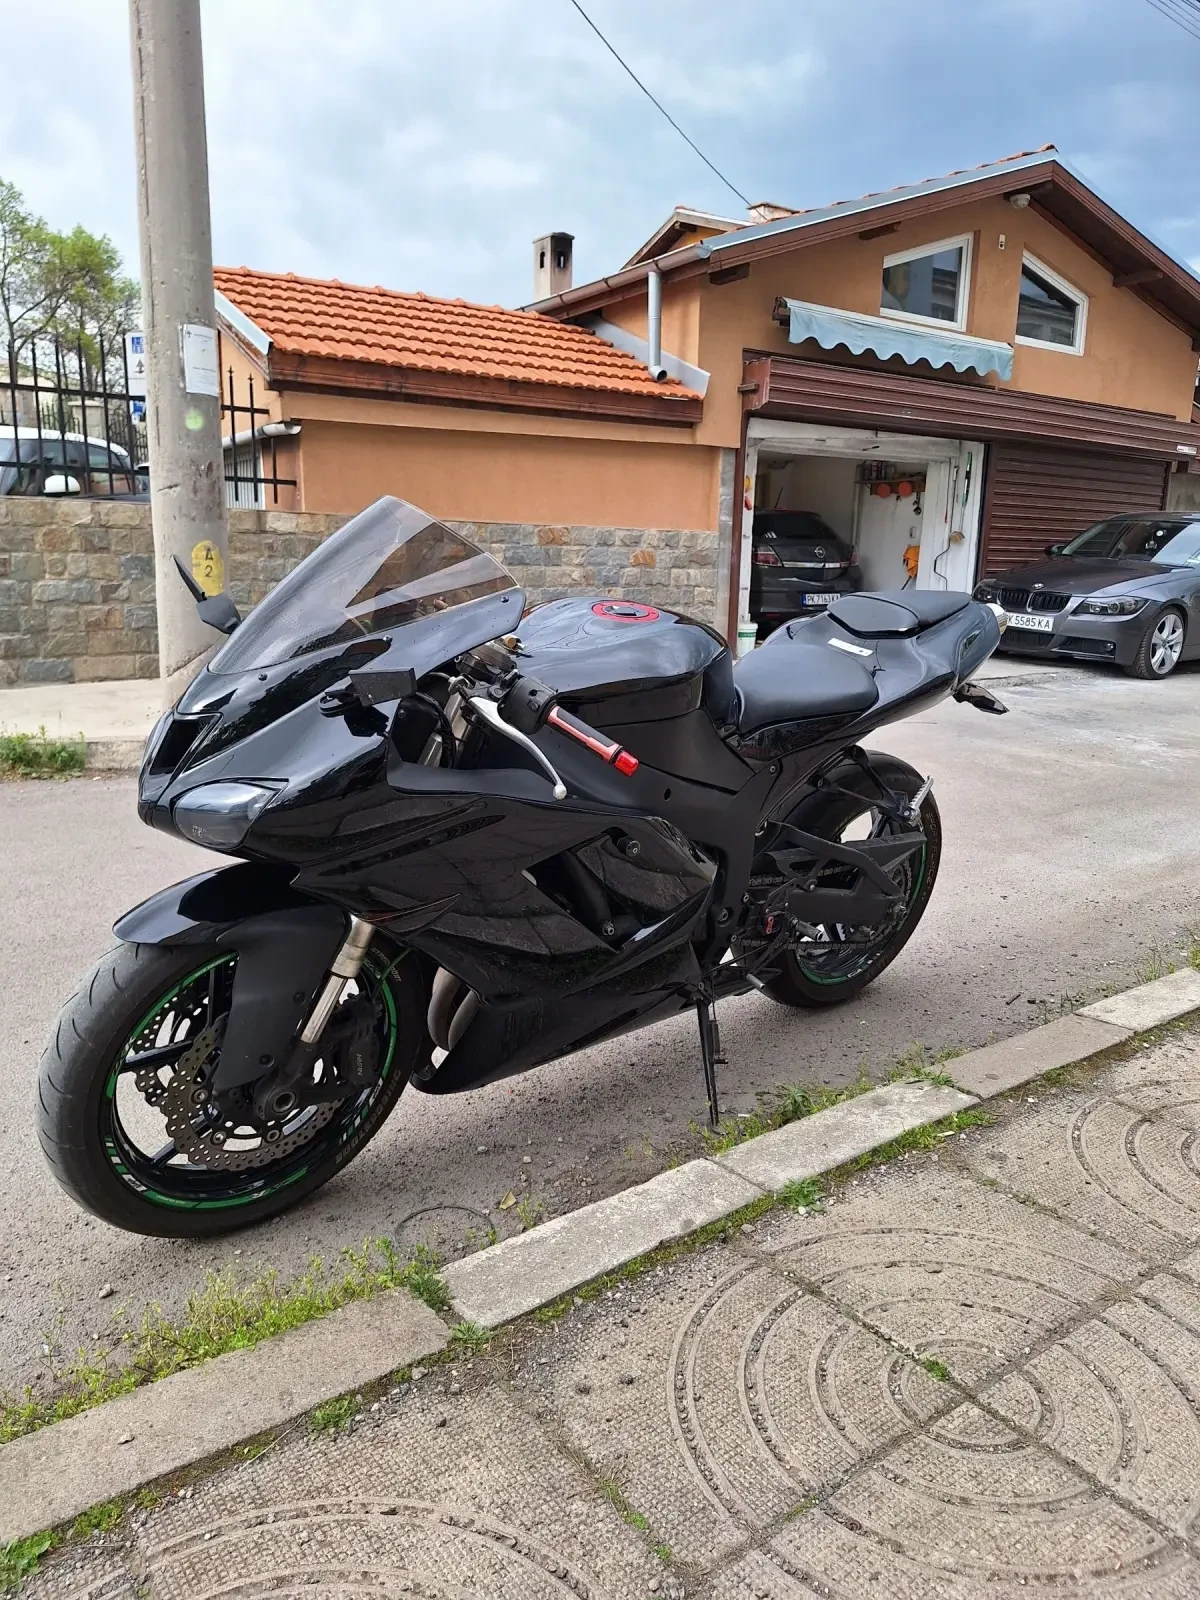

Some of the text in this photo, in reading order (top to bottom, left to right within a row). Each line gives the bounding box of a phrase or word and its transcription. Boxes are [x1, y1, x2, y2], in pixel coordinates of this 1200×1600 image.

[204, 564, 213, 578] 2
[1014, 615, 1037, 627] 5585
[1037, 618, 1050, 629] KA
